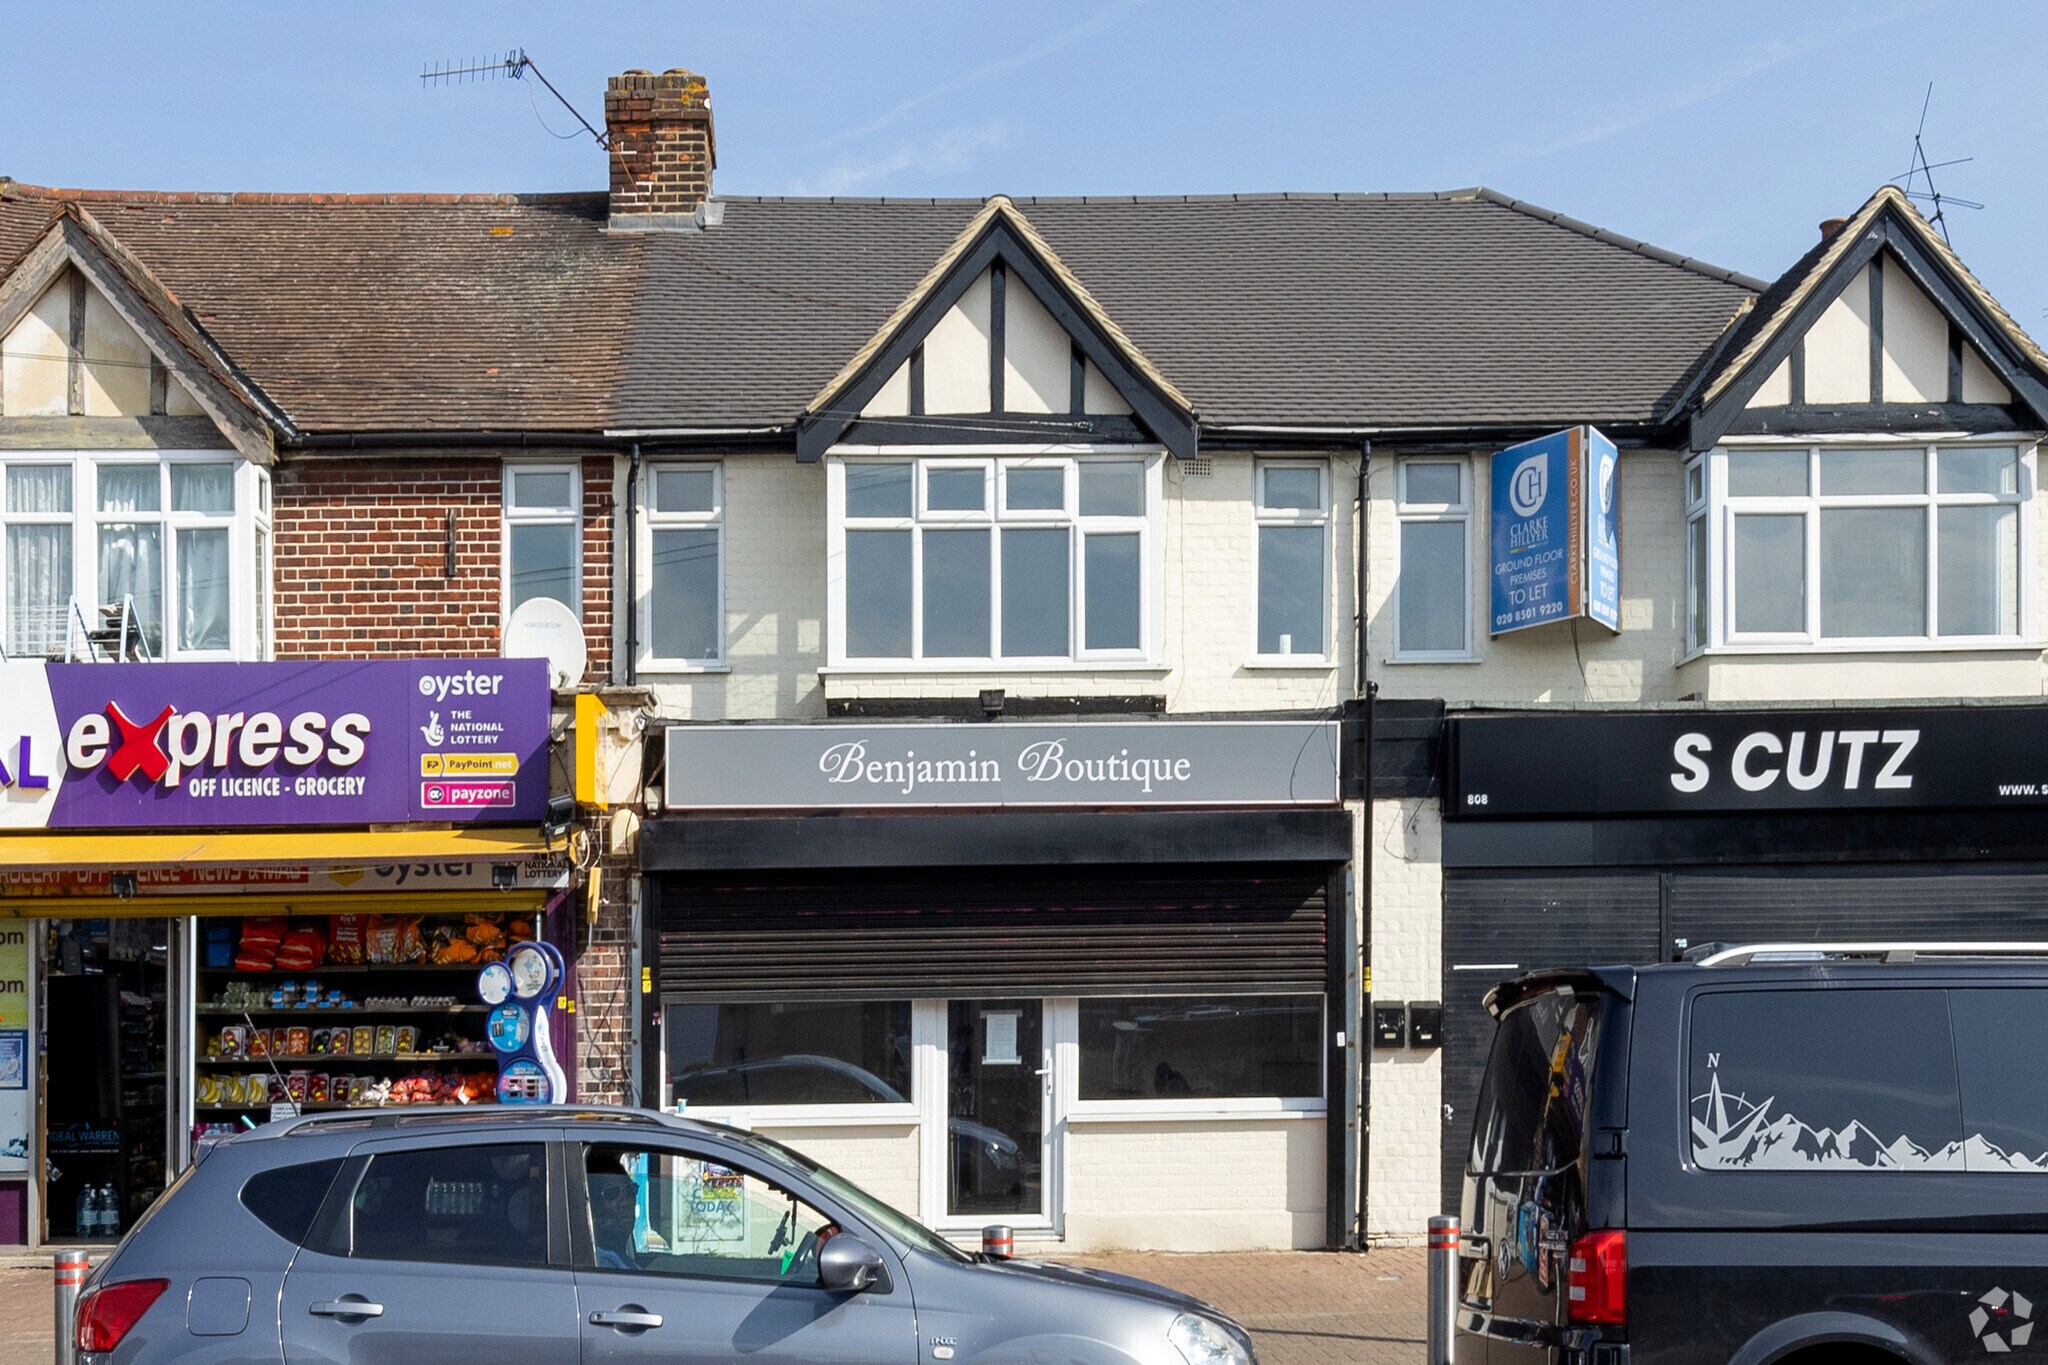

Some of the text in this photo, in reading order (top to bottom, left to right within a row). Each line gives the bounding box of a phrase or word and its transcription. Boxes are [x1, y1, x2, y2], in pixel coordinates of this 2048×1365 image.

[1510, 515, 1548, 537] CLARKE
[1570, 459, 1578, 584] CLARKEHILLYER.CO.UK
[1510, 529, 1549, 548] HILLYER
[1495, 548, 1564, 575] GROUND FLOOR
[1510, 567, 1547, 586] PREMISES
[1508, 582, 1548, 606] TO LET
[1496, 601, 1563, 625] 020 8501 9220
[419, 670, 503, 702] oyster
[450, 710, 472, 719] THE
[450, 722, 504, 732] NATIONAL
[450, 735, 499, 744] LOTTERY
[818, 738, 1191, 794] Benjamin Boutique
[1670, 728, 1920, 793] S CUTZ
[189, 778, 219, 798] OFF
[222, 777, 280, 798] LICENCE
[294, 776, 366, 797] GROCERY
[451, 787, 511, 803] payzone
[1467, 794, 1488, 805] 808
[1707, 1053, 1721, 1069] N
[48, 1130, 78, 1142] IDEAL
